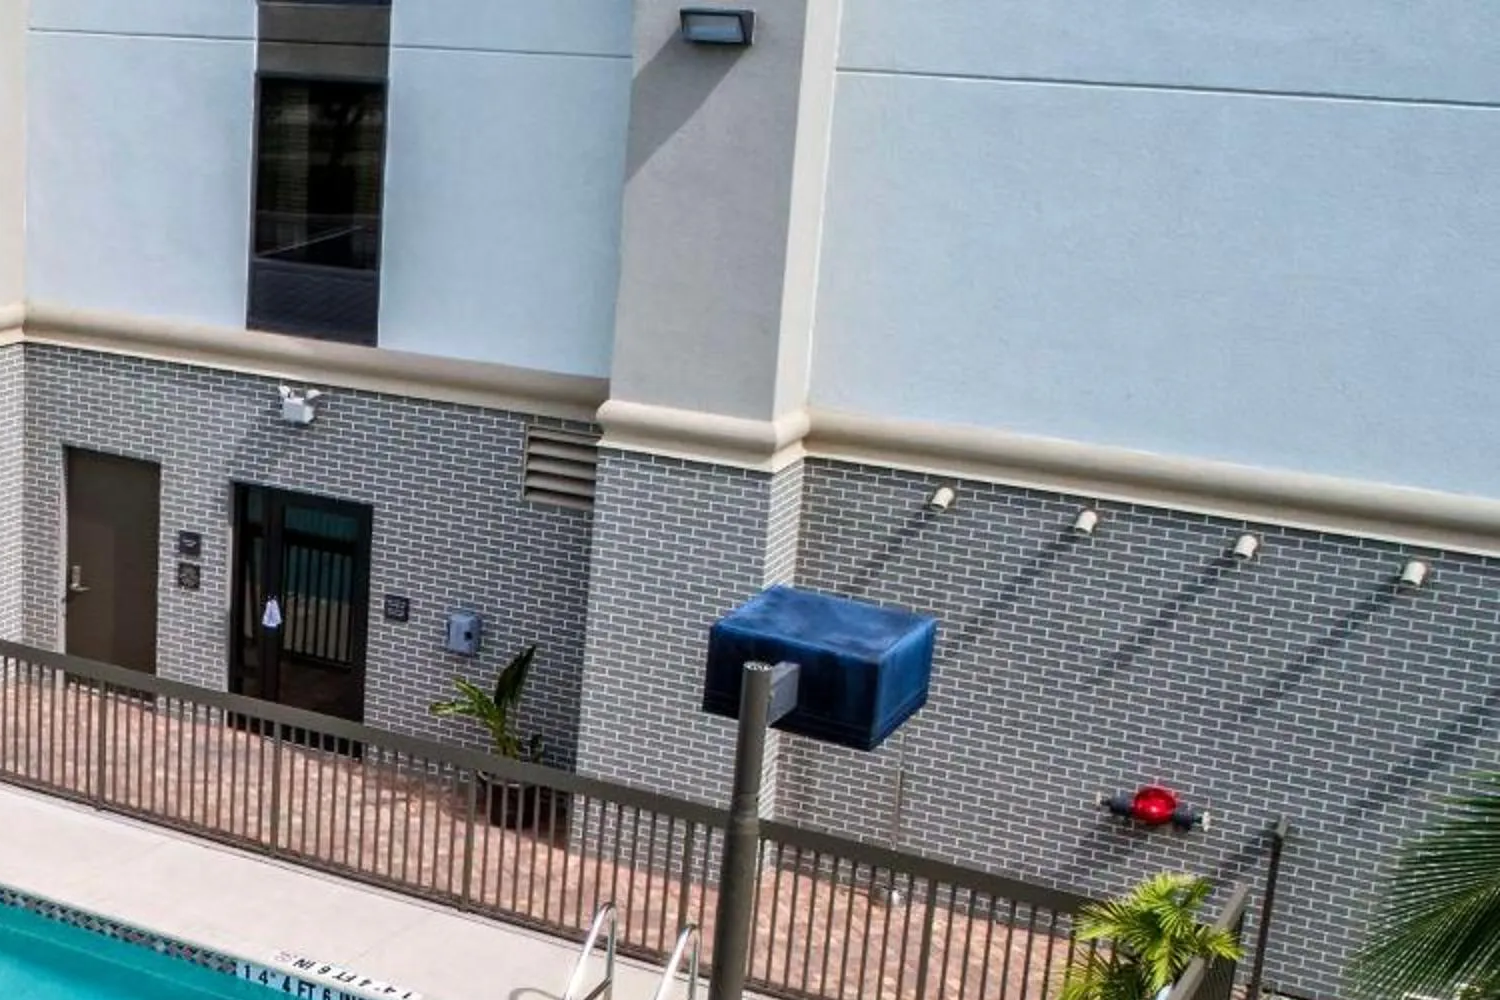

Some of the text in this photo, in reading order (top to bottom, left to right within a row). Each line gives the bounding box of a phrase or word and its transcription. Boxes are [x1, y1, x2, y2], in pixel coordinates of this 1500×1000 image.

[292, 957, 315, 970] IN
[331, 970, 359, 984] FT
[281, 975, 291, 993] 4
[297, 977, 316, 1000] FT
